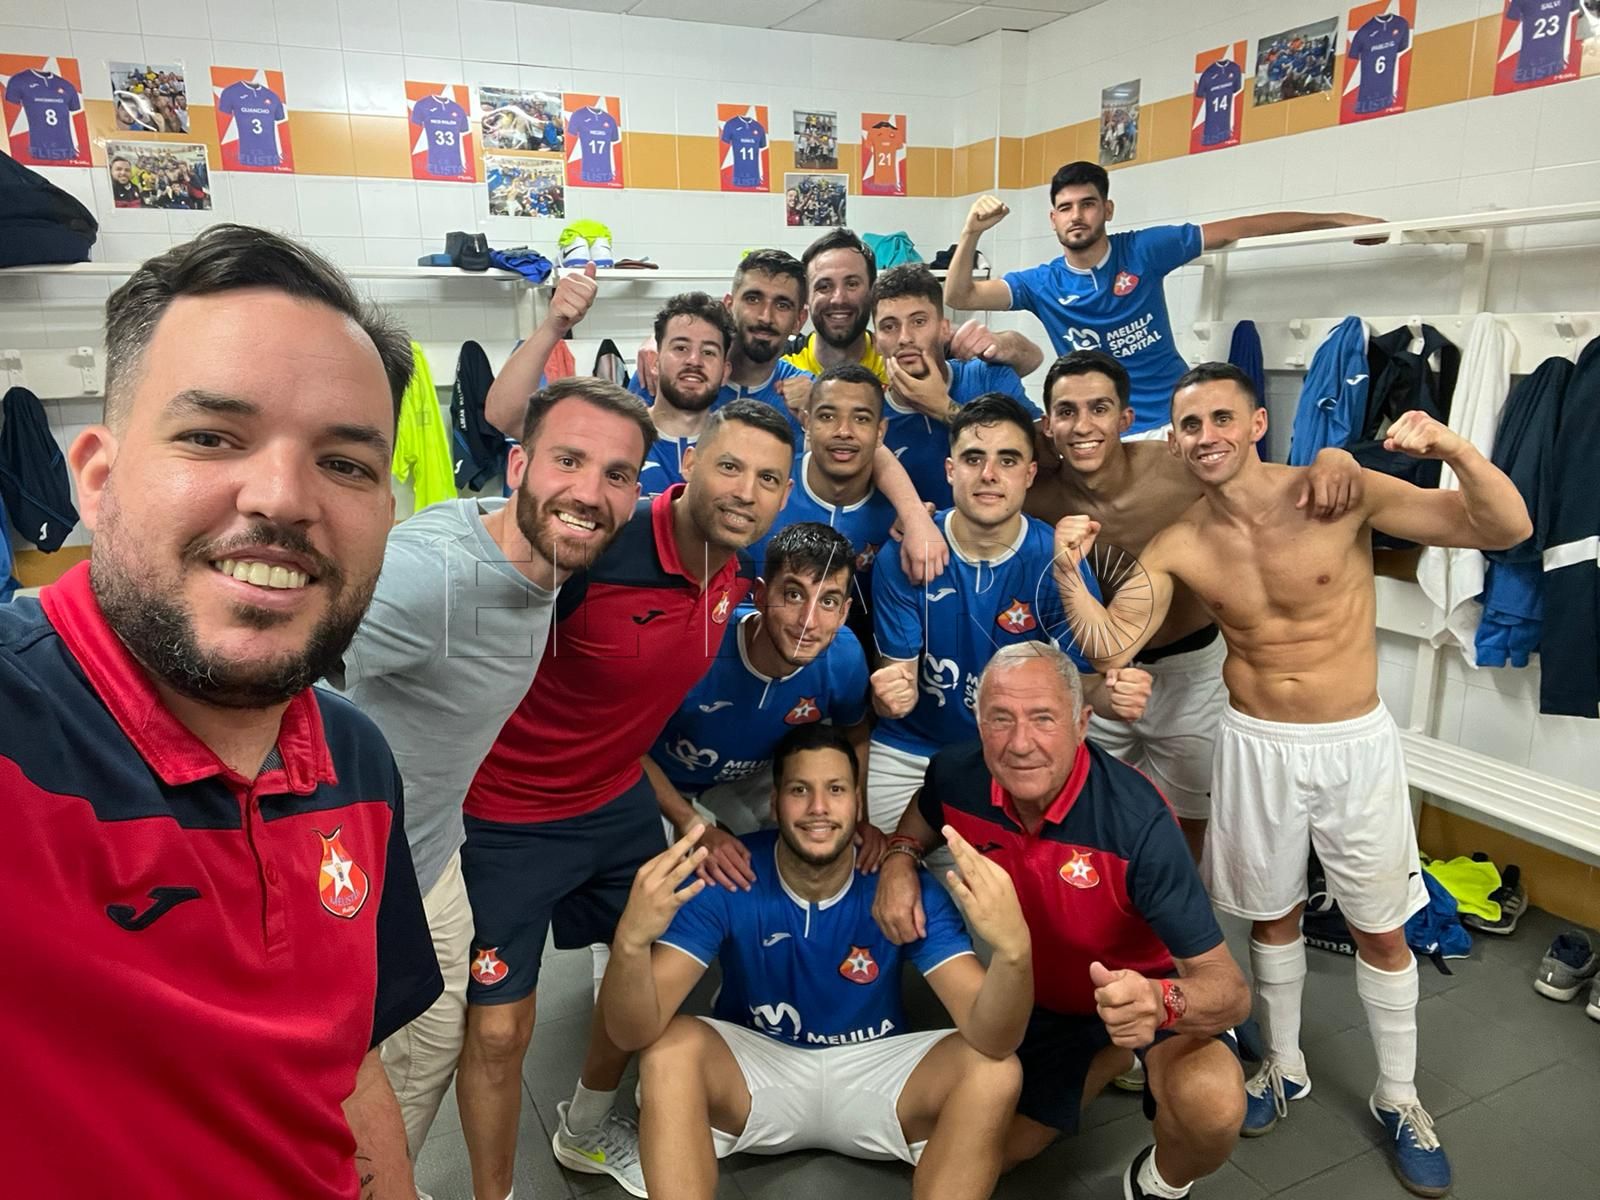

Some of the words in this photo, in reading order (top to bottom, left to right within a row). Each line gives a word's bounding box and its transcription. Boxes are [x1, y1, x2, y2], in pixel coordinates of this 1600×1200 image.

[1532, 15, 1560, 39] 23
[1375, 55, 1386, 74] 6
[1212, 95, 1228, 113] 14
[45, 109, 58, 126] 8
[251, 118, 263, 134] 3
[434, 130, 455, 146] 33
[588, 139, 606, 155] 17
[739, 147, 754, 161] 11
[878, 152, 891, 166] 21
[1106, 313, 1154, 342] MELILLA
[1108, 327, 1149, 351] SPORT
[1112, 330, 1162, 358] CAPITAL
[807, 1019, 896, 1045] MELILLA
